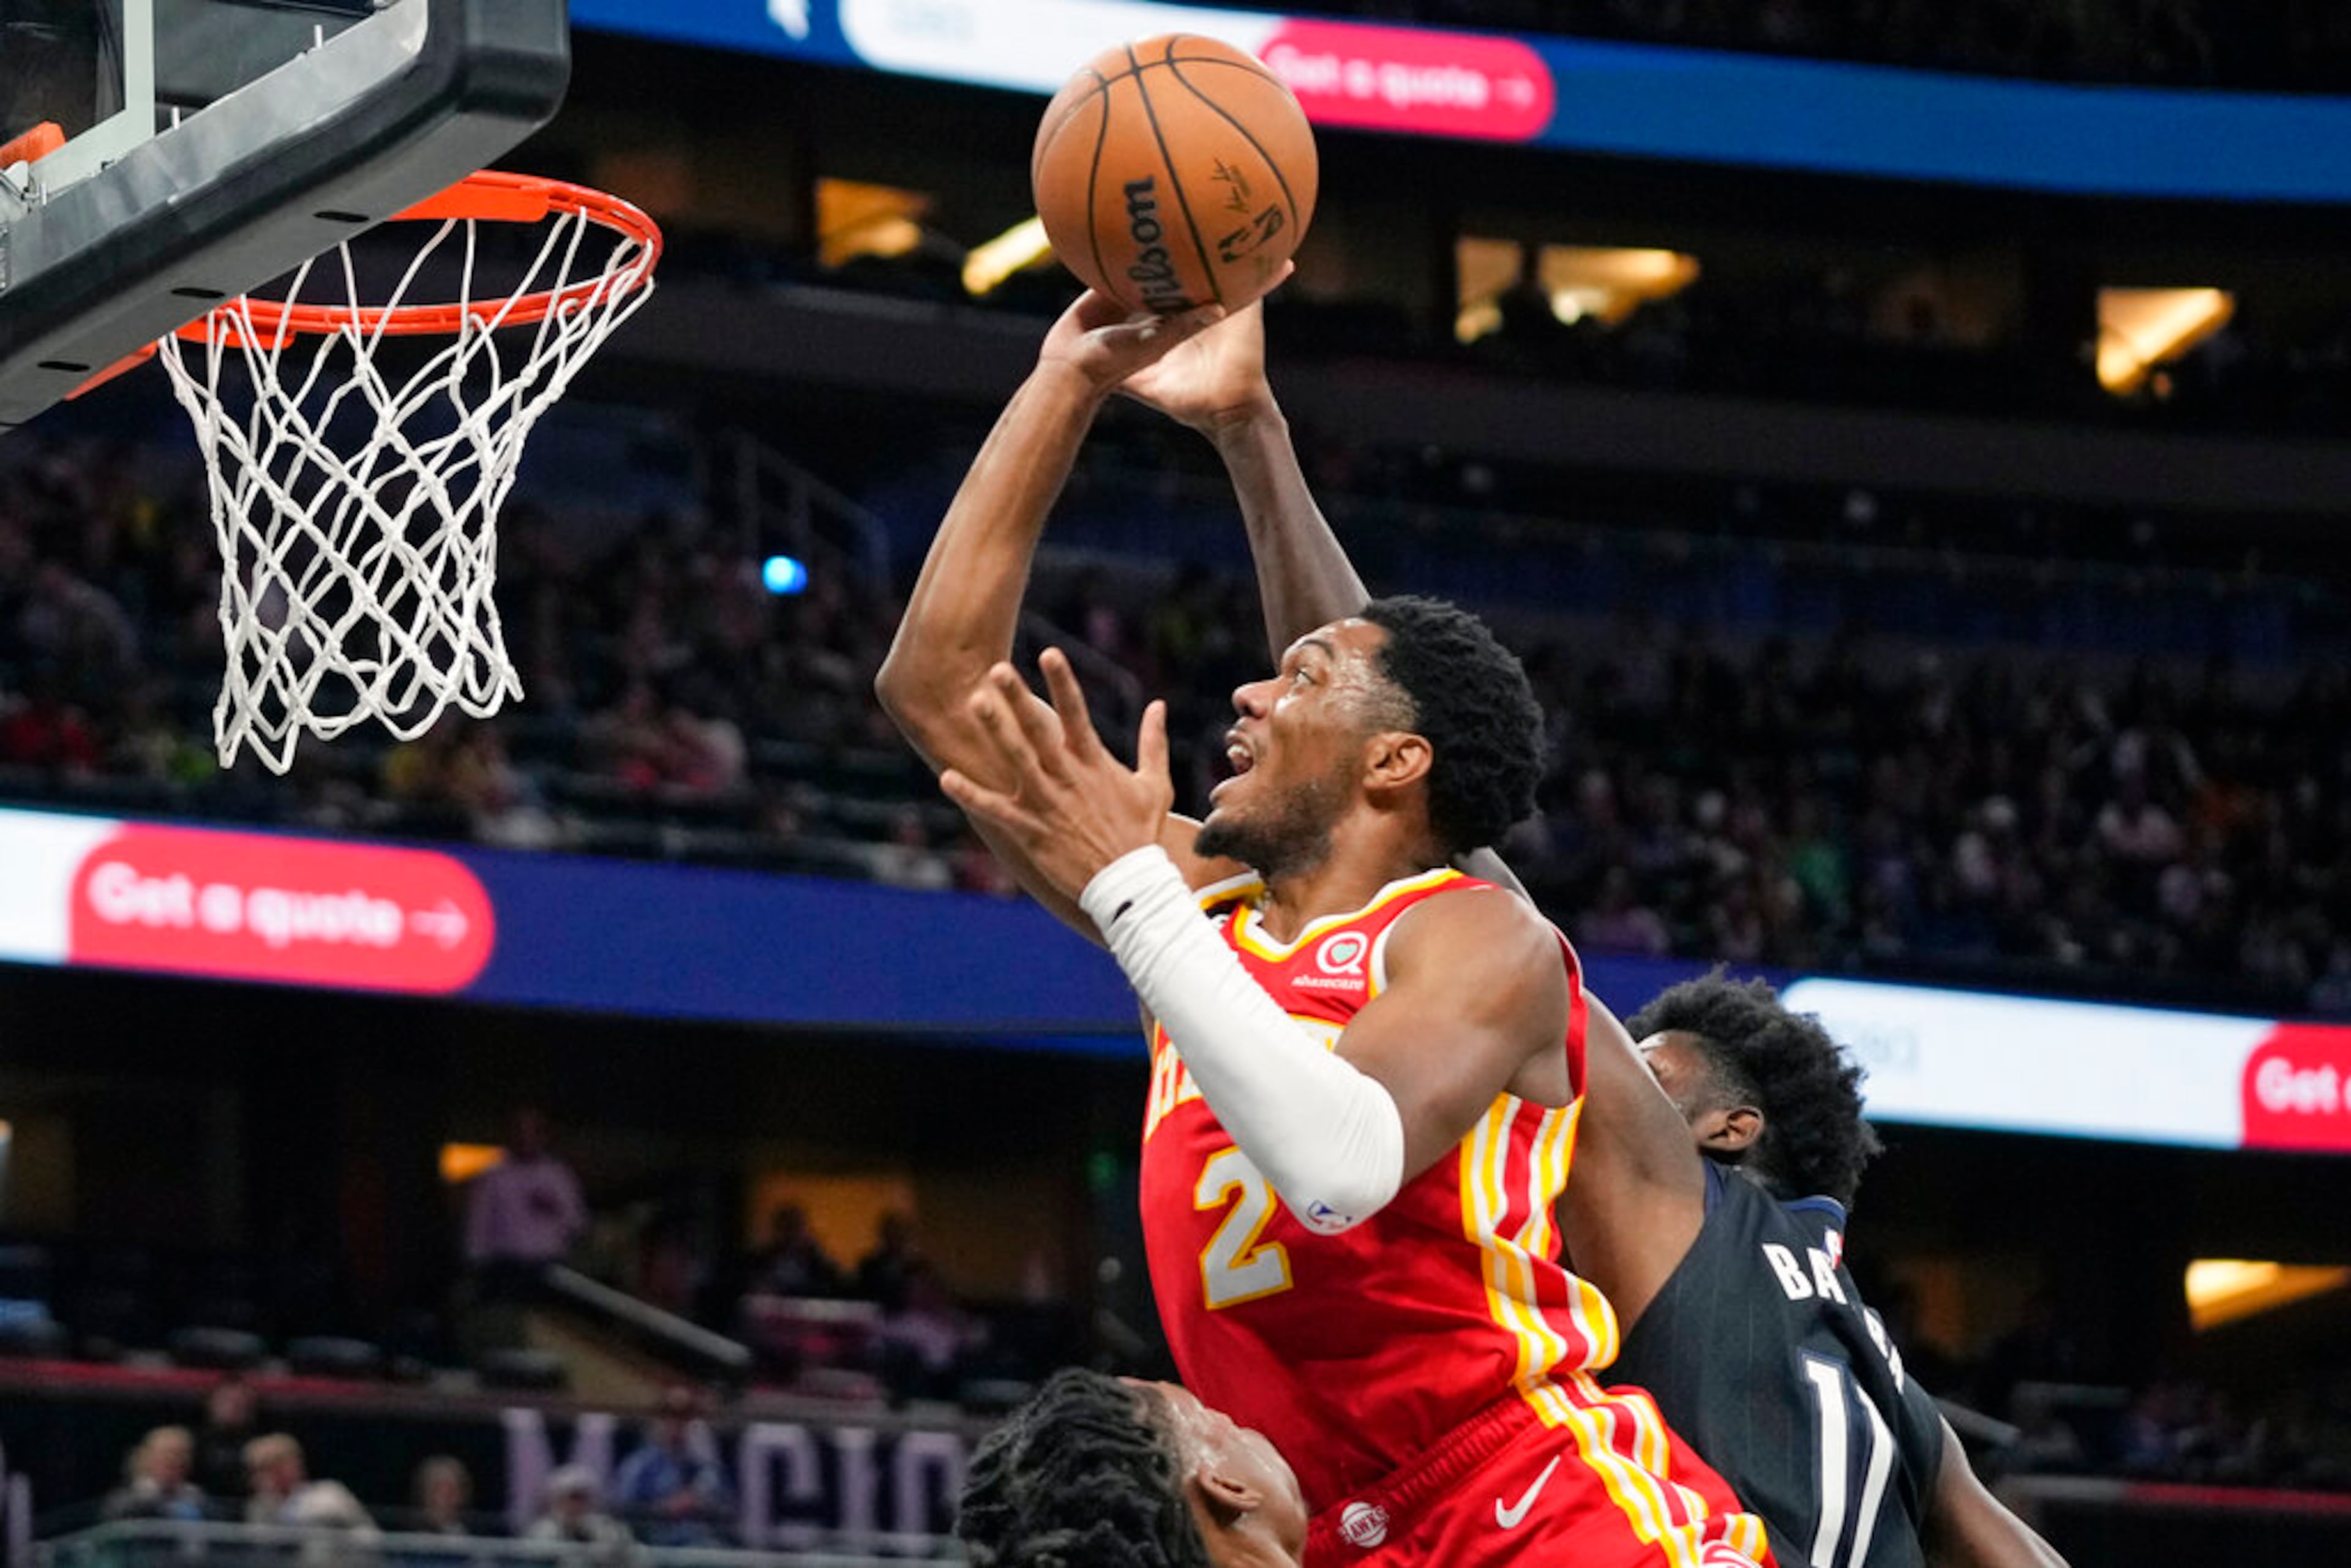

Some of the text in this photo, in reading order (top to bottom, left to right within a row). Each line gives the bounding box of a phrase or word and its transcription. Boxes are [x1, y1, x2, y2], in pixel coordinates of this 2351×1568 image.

[88, 860, 403, 949] Get a quote
[2255, 1056, 2339, 1116] Get
[1194, 1145, 1293, 1311] 2
[502, 1407, 969, 1556] MGIC
